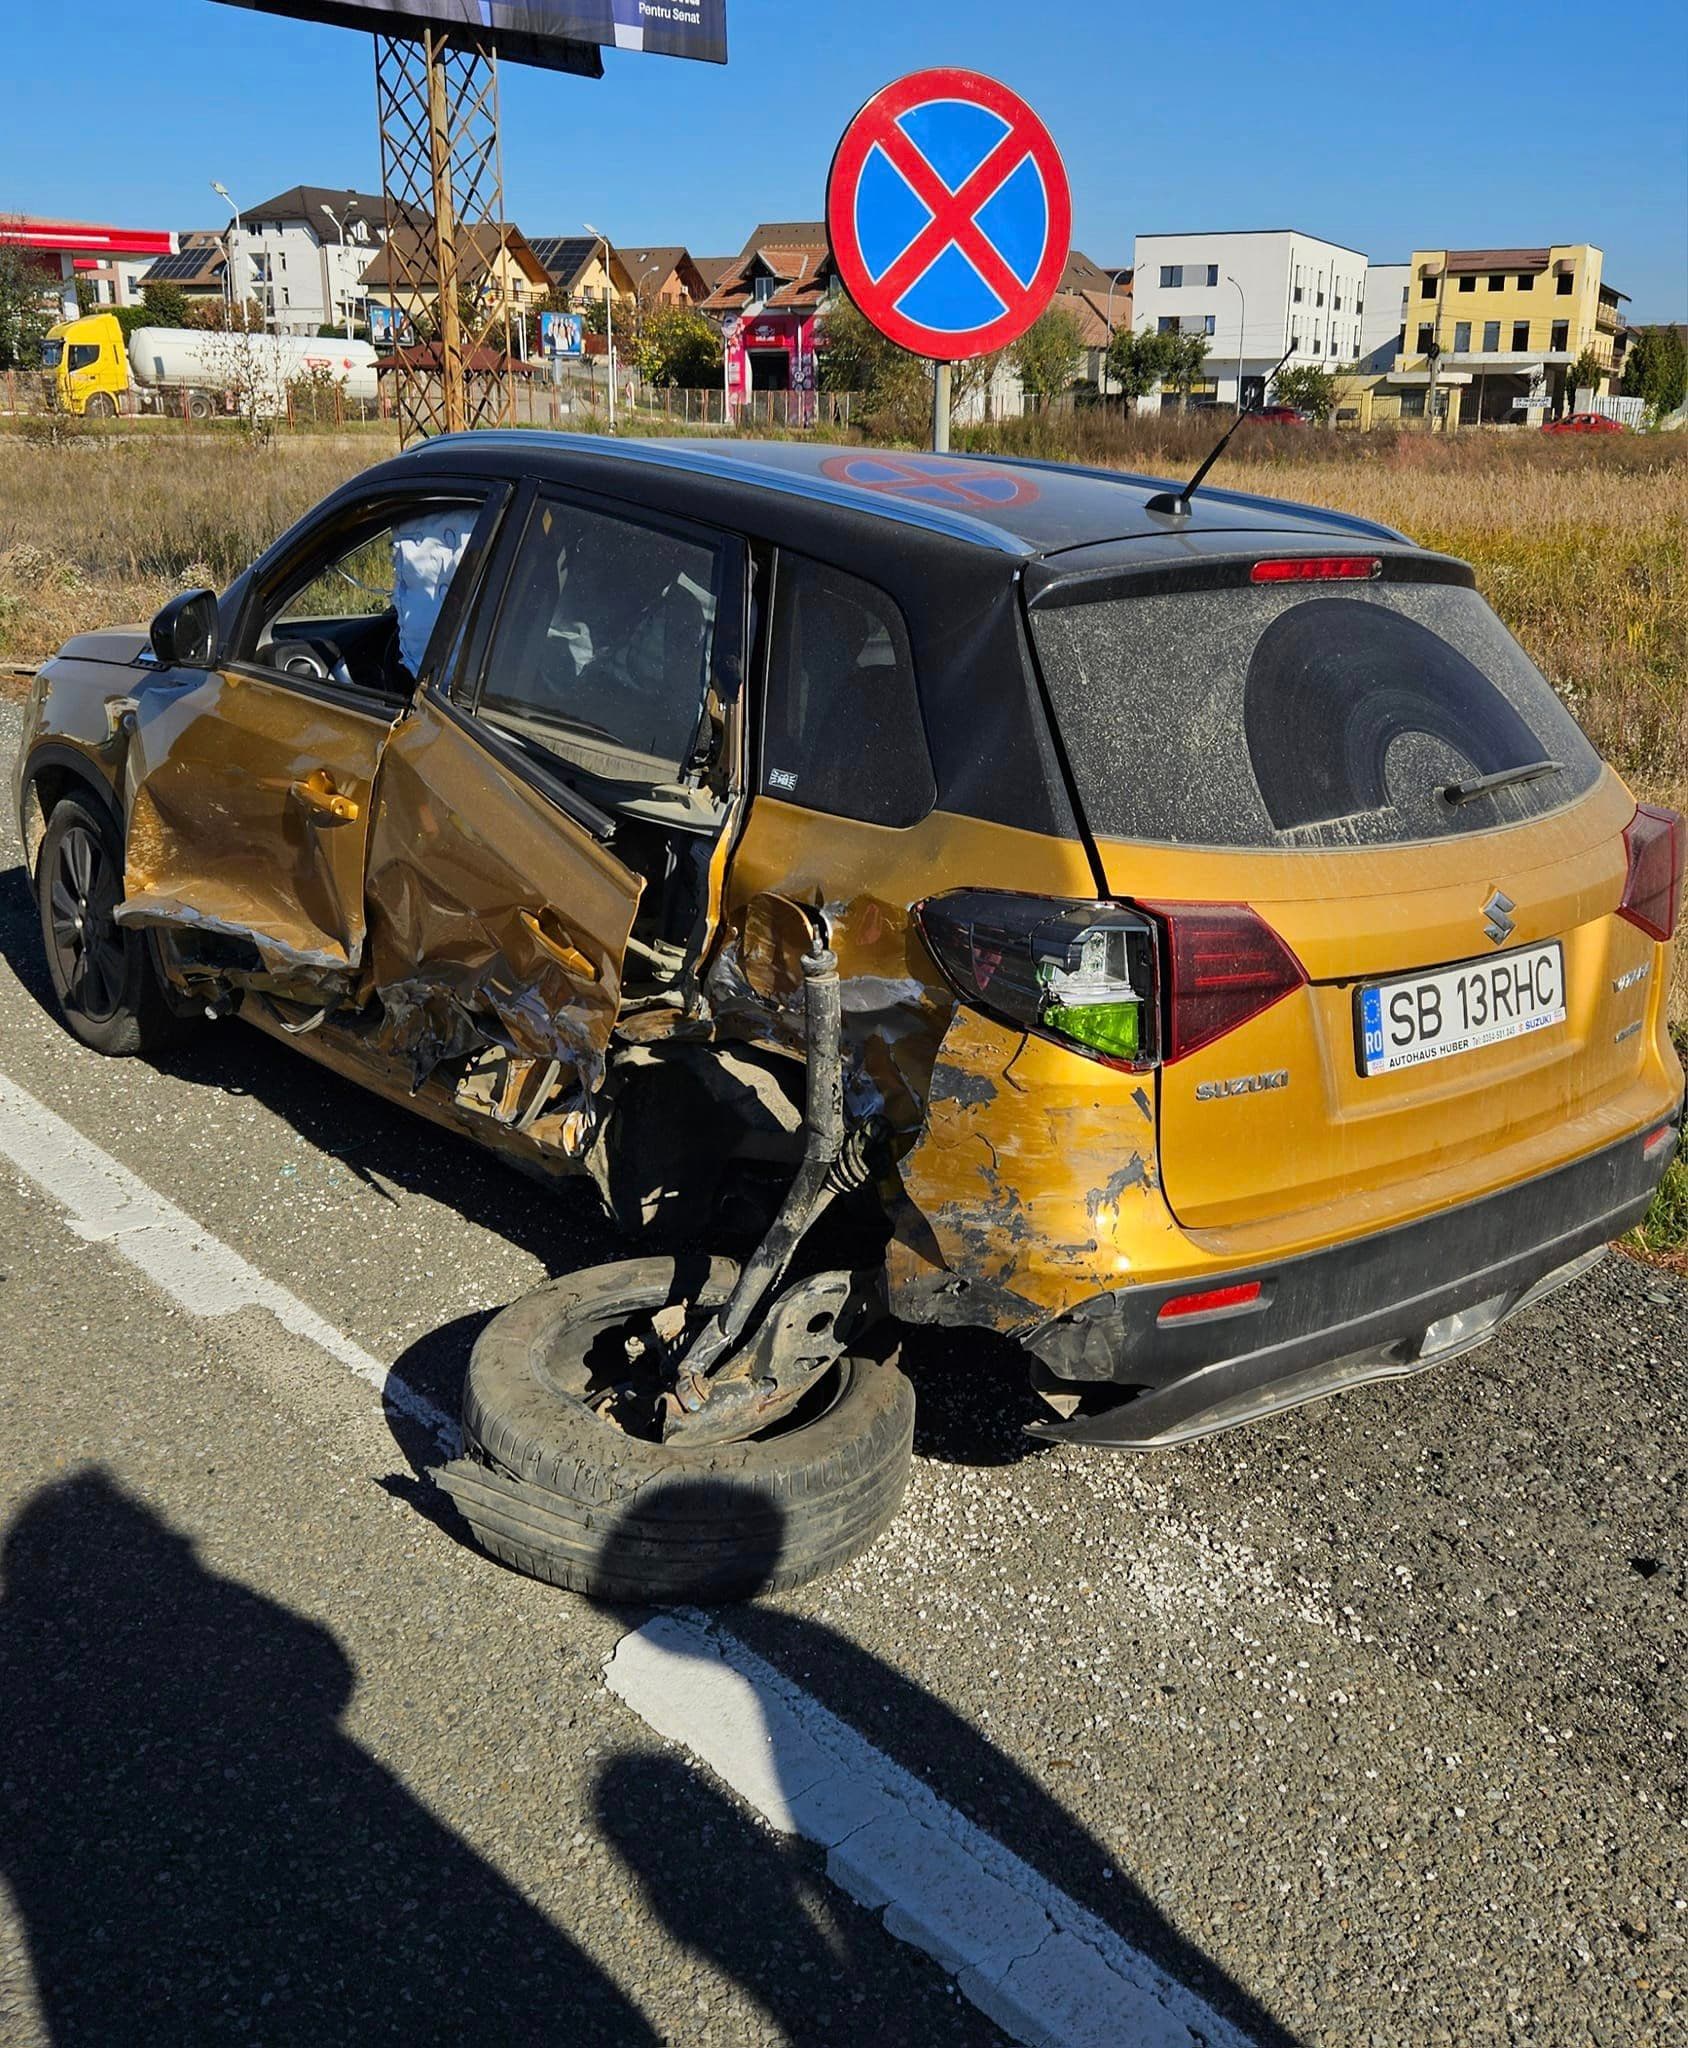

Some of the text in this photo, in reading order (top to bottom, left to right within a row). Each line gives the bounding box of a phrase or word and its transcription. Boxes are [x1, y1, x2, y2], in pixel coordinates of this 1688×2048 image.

[639, 2, 700, 24] Pentru Senat
[1389, 984, 1442, 1046] SB
[1365, 1031, 1383, 1055] RO
[1389, 1047, 1437, 1068] AUTOHAUS
[1440, 1039, 1469, 1056] HUBER
[1525, 1015, 1552, 1029] SUZUKI
[1196, 1070, 1289, 1101] SUZUKI
